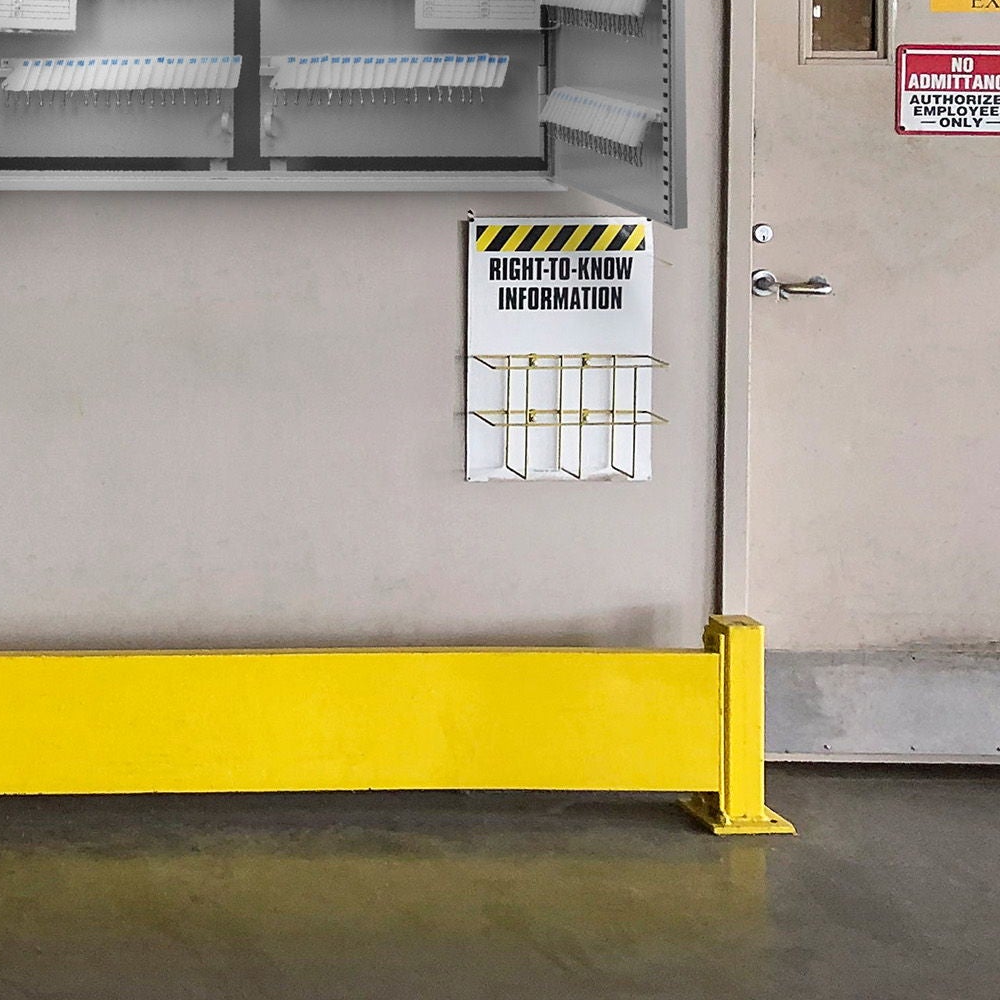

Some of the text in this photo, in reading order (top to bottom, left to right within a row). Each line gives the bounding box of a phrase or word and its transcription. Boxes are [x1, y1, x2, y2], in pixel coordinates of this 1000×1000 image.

[951, 56, 975, 73] NO
[913, 106, 999, 117] EMPLOYEE
[939, 117, 983, 128] ONLY
[489, 256, 634, 281] RIGHT-TO-KNOW
[498, 286, 623, 310] INFORMATION
